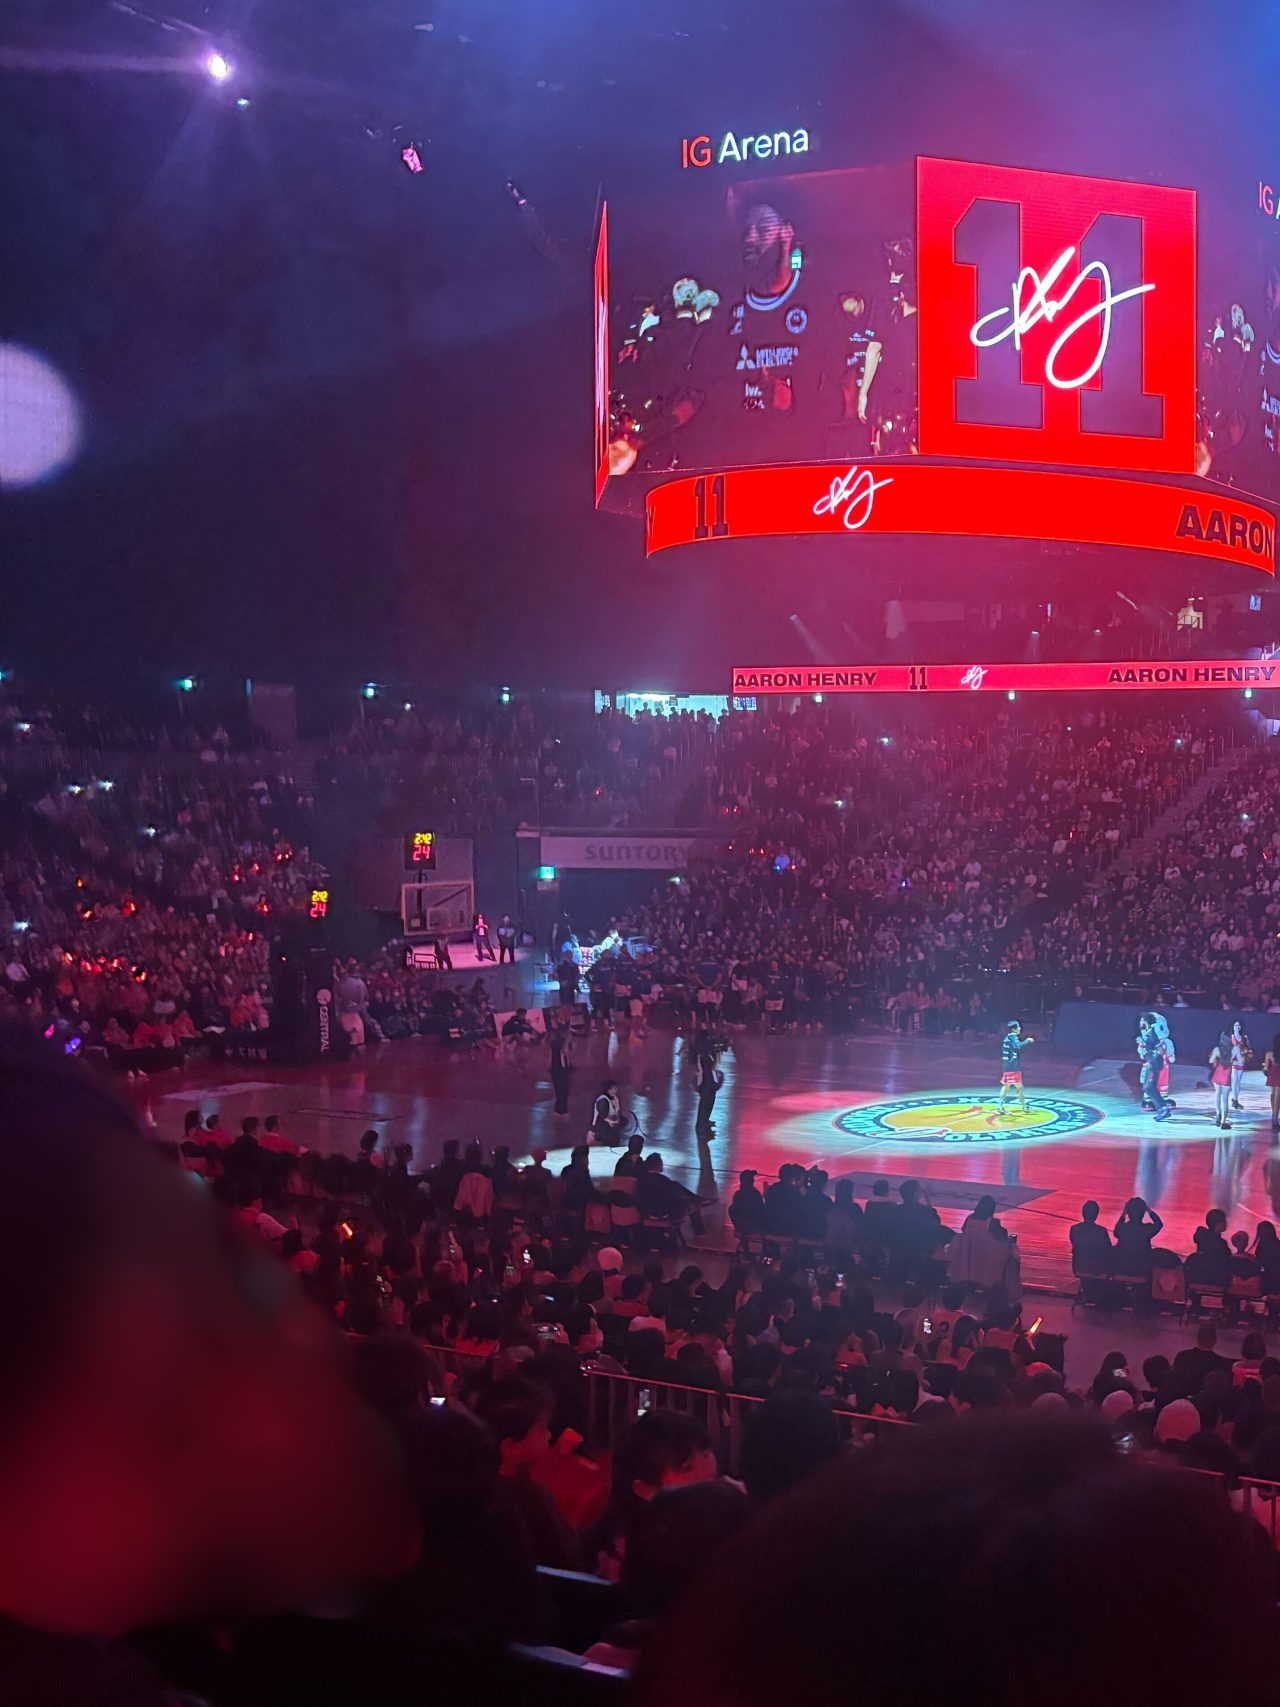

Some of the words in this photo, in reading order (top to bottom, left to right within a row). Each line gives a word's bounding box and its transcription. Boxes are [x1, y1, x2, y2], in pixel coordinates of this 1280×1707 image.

[682, 136, 711, 168] IG
[718, 129, 809, 163] Arena
[1259, 181, 1274, 215] IG
[953, 198, 1165, 440] 11
[694, 475, 729, 540] 11
[1175, 504, 1274, 560] AARON
[735, 672, 801, 687] AARON
[807, 671, 877, 686] HENRY
[909, 667, 928, 690] 11
[1107, 667, 1187, 683] AARON
[1194, 666, 1276, 682] HENRY
[413, 845, 431, 861] 24
[310, 902, 327, 918] 24
